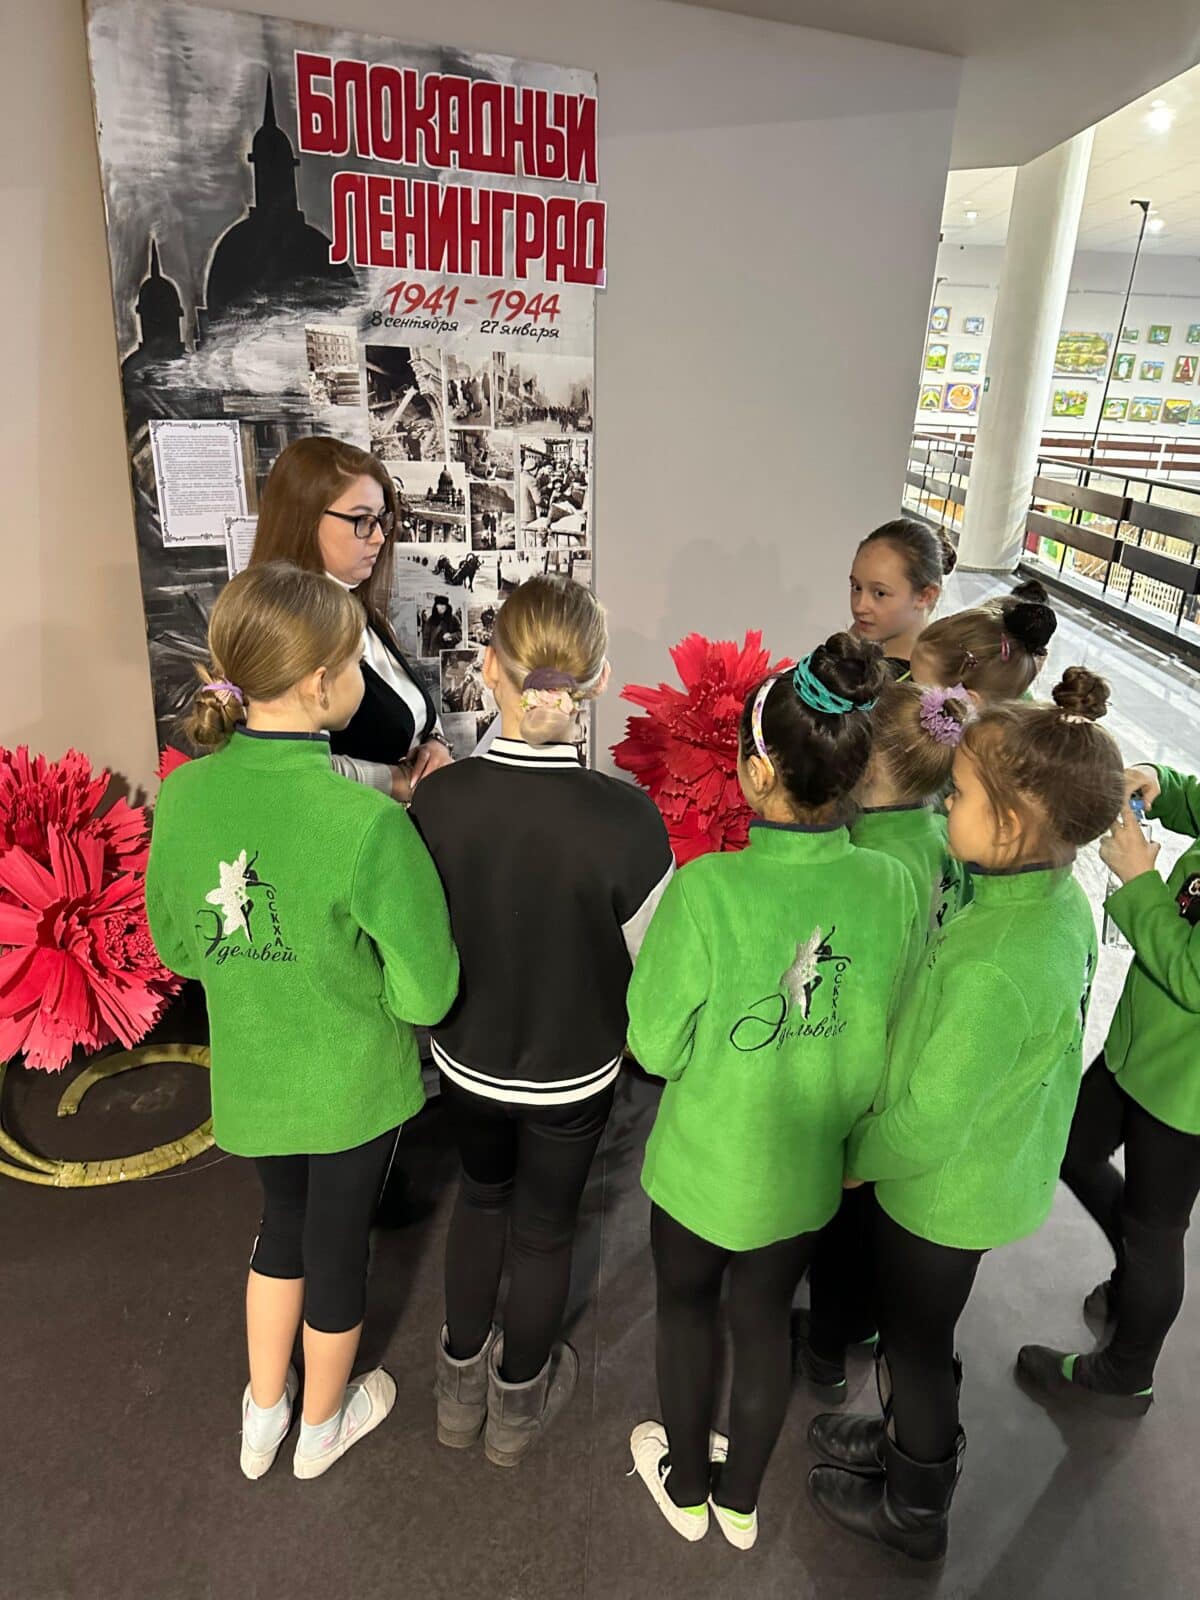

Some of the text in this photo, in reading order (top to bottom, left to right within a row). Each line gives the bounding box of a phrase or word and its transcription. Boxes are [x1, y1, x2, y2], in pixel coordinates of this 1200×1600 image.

[295, 50, 598, 184] БЛОКАДНЫЙ
[329, 171, 606, 288] ЛЕНИНГРАД
[370, 310, 560, 343] 8 сентября 27 января
[384, 280, 460, 316] 1941
[486, 288, 561, 324] 1944
[195, 908, 298, 966] Эдельвей
[729, 992, 848, 1052] Эдльвес
